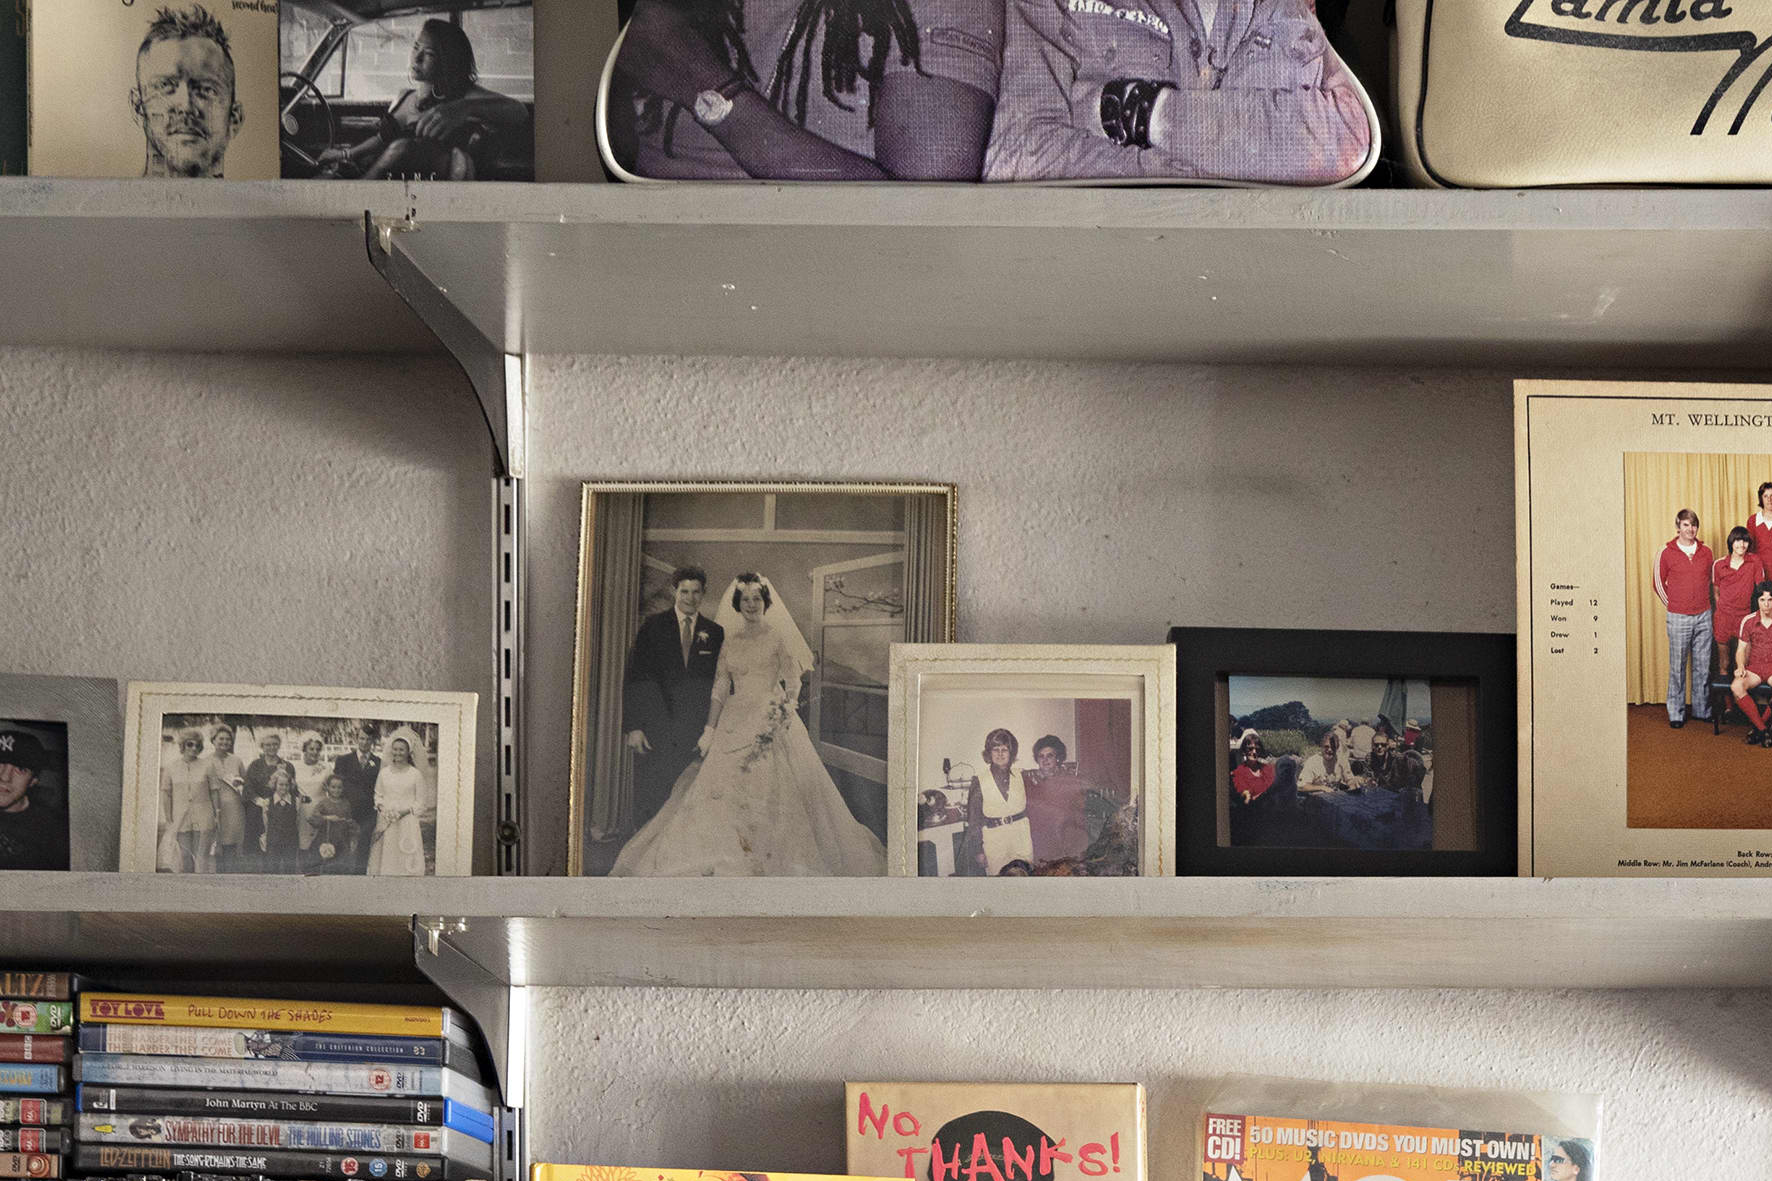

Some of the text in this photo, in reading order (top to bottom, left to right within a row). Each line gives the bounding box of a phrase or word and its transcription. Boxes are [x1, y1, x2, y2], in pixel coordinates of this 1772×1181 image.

[1651, 413, 1680, 426] MT.
[1550, 599, 1598, 607] Played 12
[1550, 647, 1599, 655] Lost 2
[90, 1000, 165, 1019] TOY LOVE
[187, 1006, 333, 1023] PULL DOWN THE SHADES
[205, 1098, 319, 1112] John Martyn At The BBC
[164, 1120, 282, 1146] SYMPATHY FOR THE DEVIL
[1208, 1118, 1242, 1136] FREE
[287, 1126, 382, 1149] THE ROLLING STONES
[1250, 1126, 1537, 1161] 50 MUSIC DVDS YOU MUST OWN!
[1208, 1137, 1241, 1160] CD!
